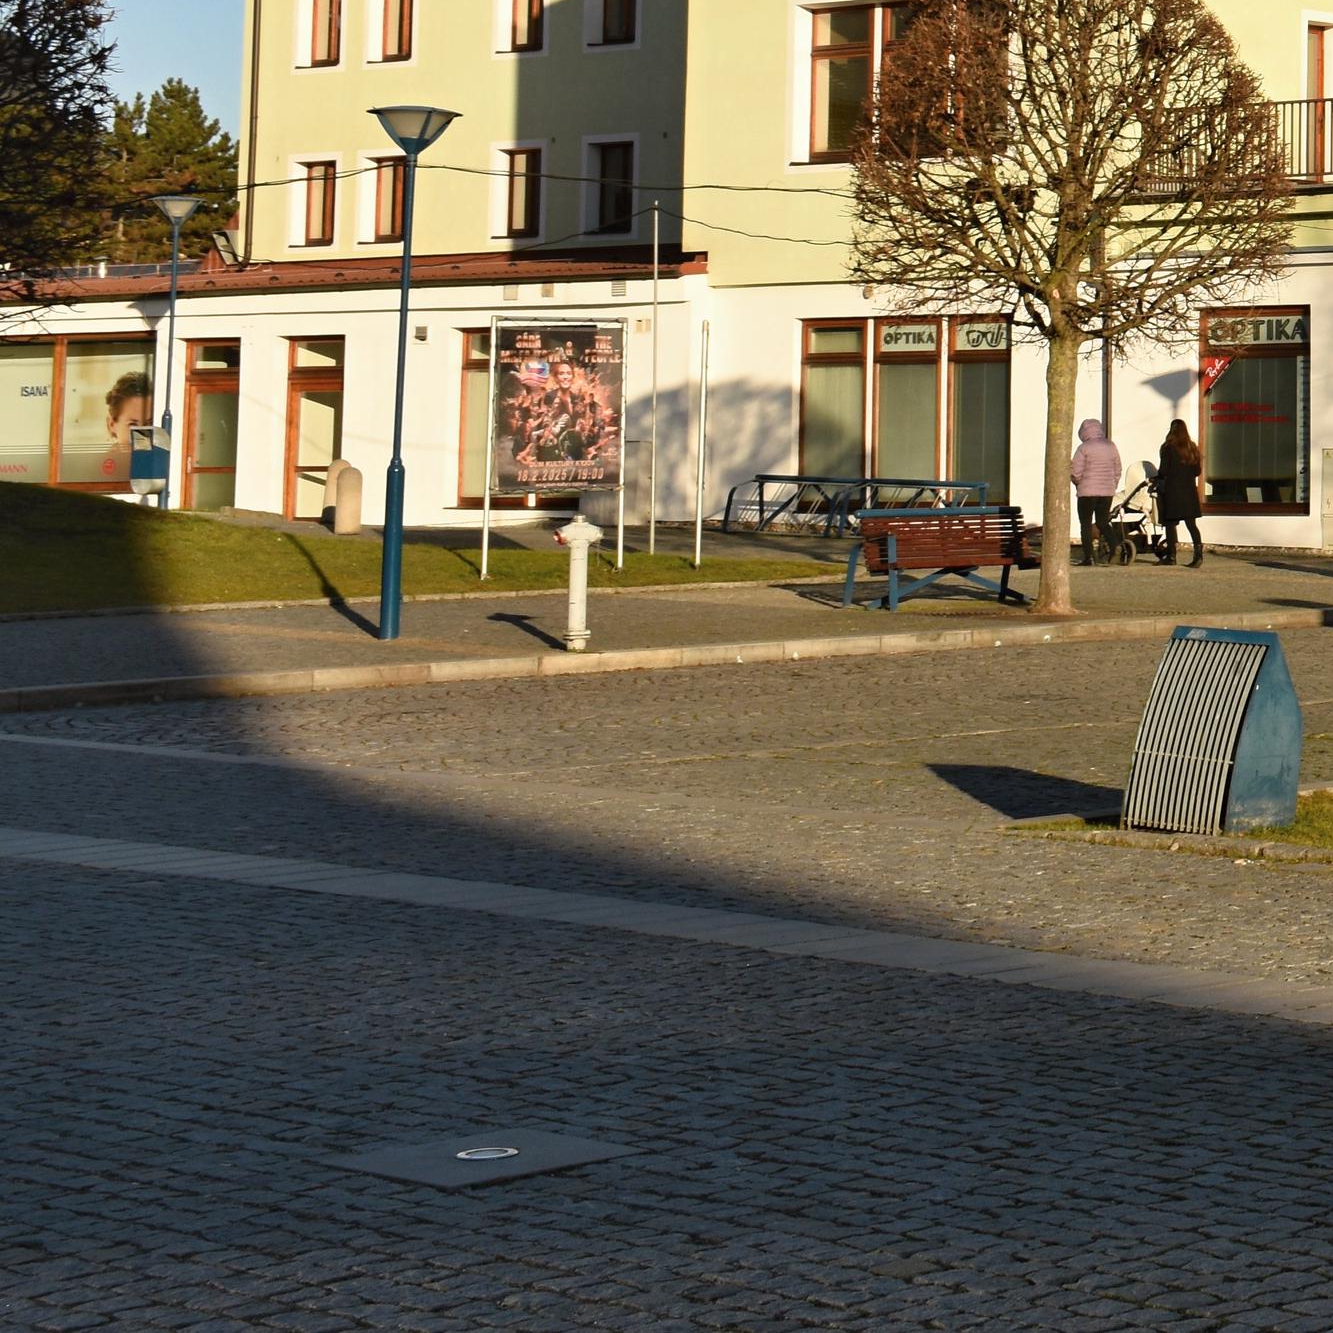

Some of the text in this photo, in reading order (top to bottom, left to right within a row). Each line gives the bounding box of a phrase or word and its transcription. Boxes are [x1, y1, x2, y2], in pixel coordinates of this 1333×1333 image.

[1210, 318, 1305, 342] OPTIKA
[884, 331, 935, 345] OPTIKA
[20, 386, 48, 397] ISANA
[517, 468, 567, 482] 18.2.2025
[577, 467, 605, 480] 19:00
